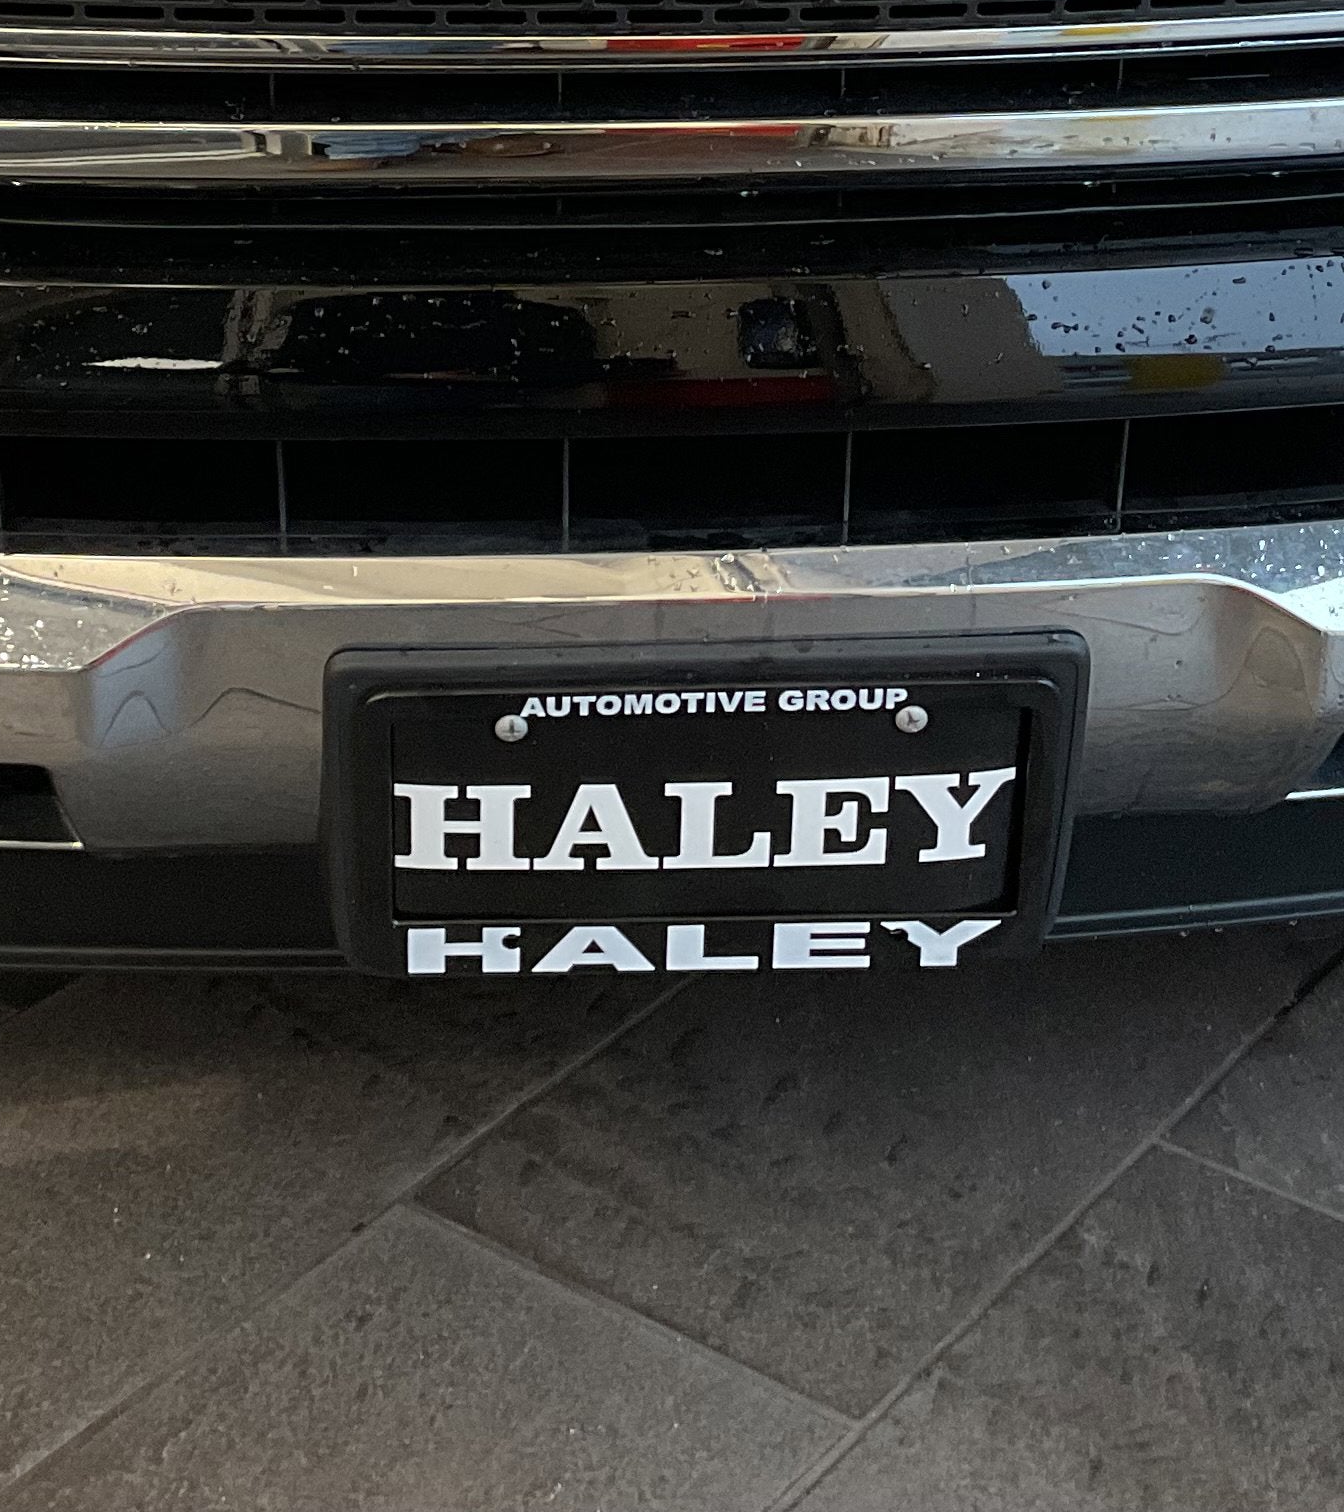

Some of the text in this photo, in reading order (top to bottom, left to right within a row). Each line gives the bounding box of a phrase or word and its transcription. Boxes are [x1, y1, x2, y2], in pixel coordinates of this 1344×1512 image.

[520, 687, 908, 718] AUTOMOTIVE GROUP
[394, 767, 1016, 870] HALEY
[408, 919, 1002, 974] HALEY
